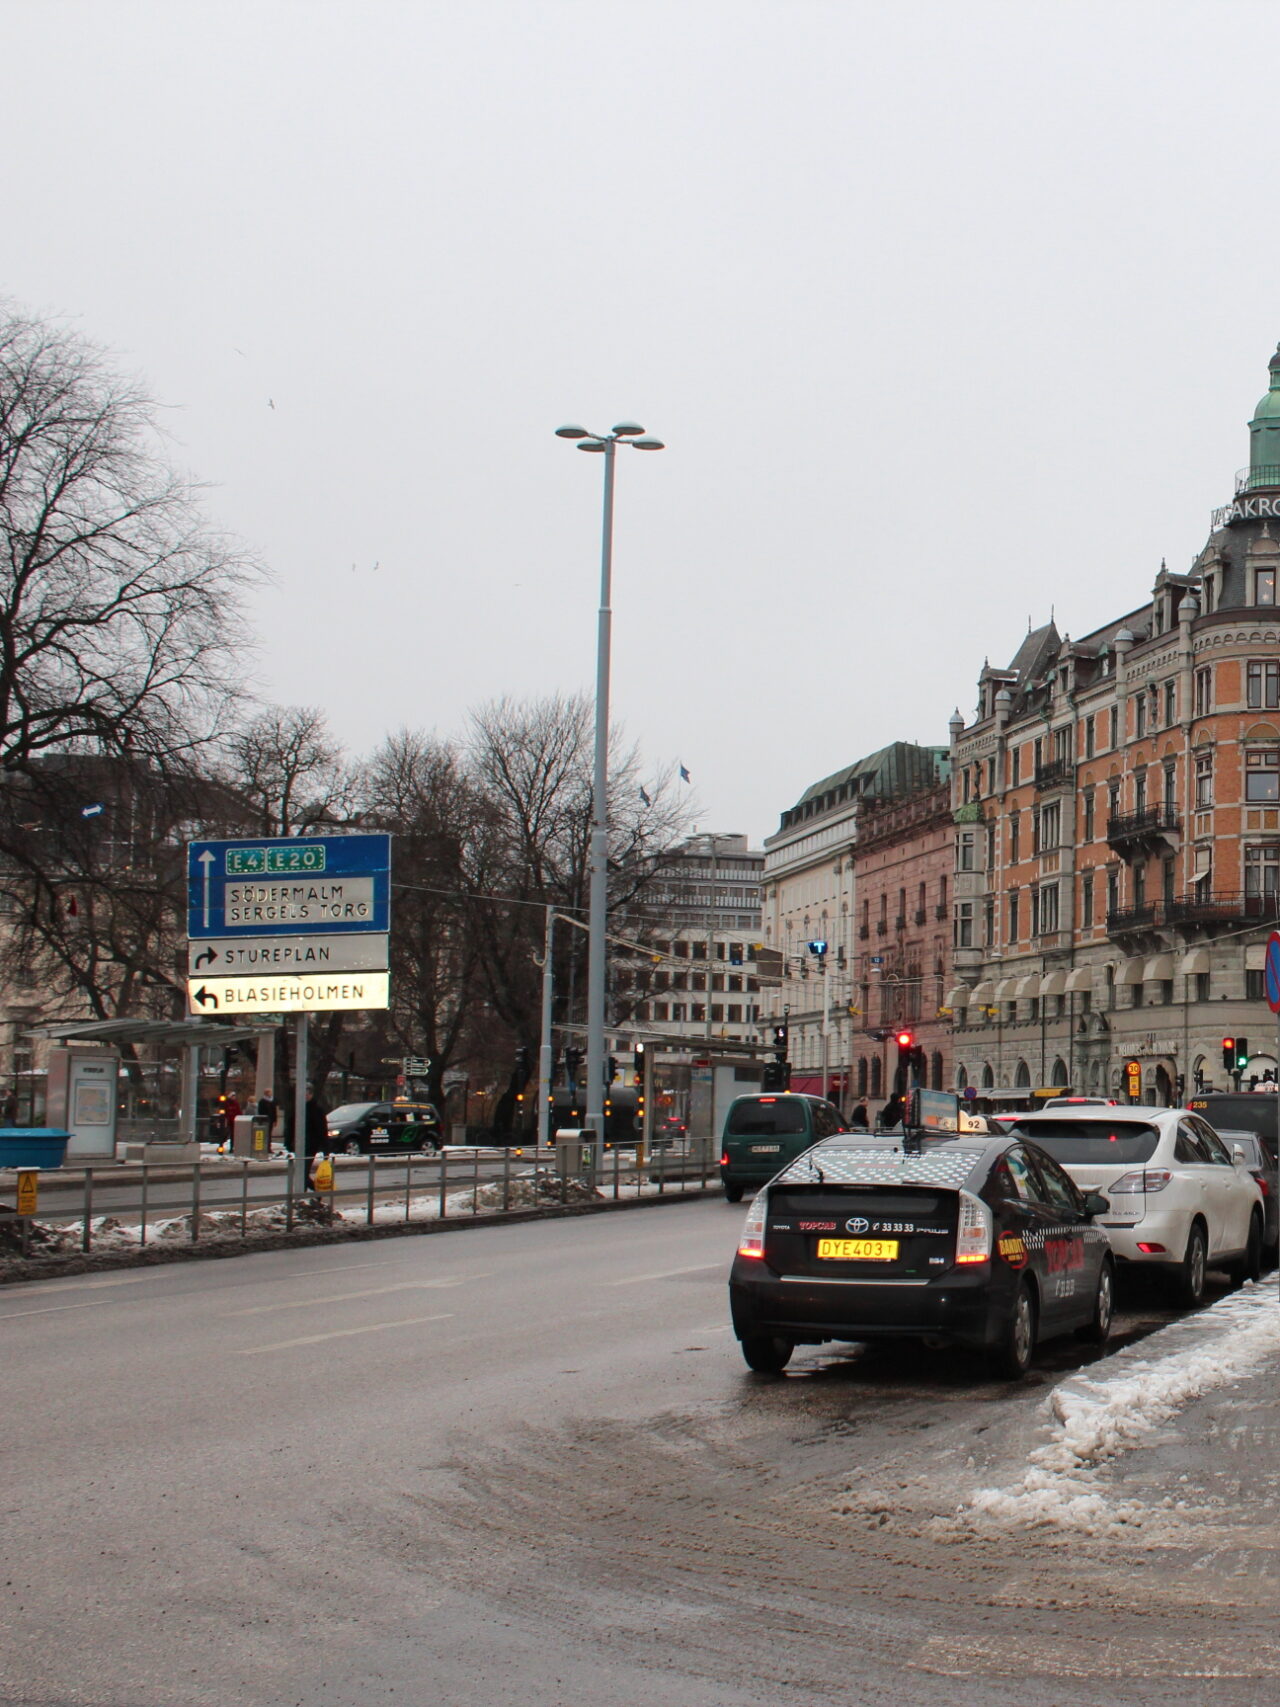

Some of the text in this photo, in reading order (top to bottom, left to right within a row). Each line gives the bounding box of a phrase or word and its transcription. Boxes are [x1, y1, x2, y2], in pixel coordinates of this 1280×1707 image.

[233, 850, 316, 869] E4 E20
[230, 884, 344, 903] SÖDERMALM
[230, 902, 369, 922] SERGELS TORG
[225, 946, 330, 964] STUREPLAN
[813, 942, 825, 953] T
[224, 984, 364, 1003] BLASIEHOLMEN
[1129, 1065, 1139, 1073] 30
[1192, 1101, 1208, 1109] 235
[967, 1120, 980, 1129] 92
[881, 1223, 914, 1233] 33 33 33
[821, 1241, 883, 1257] DYE403
[998, 1238, 1024, 1256] BANDIT
